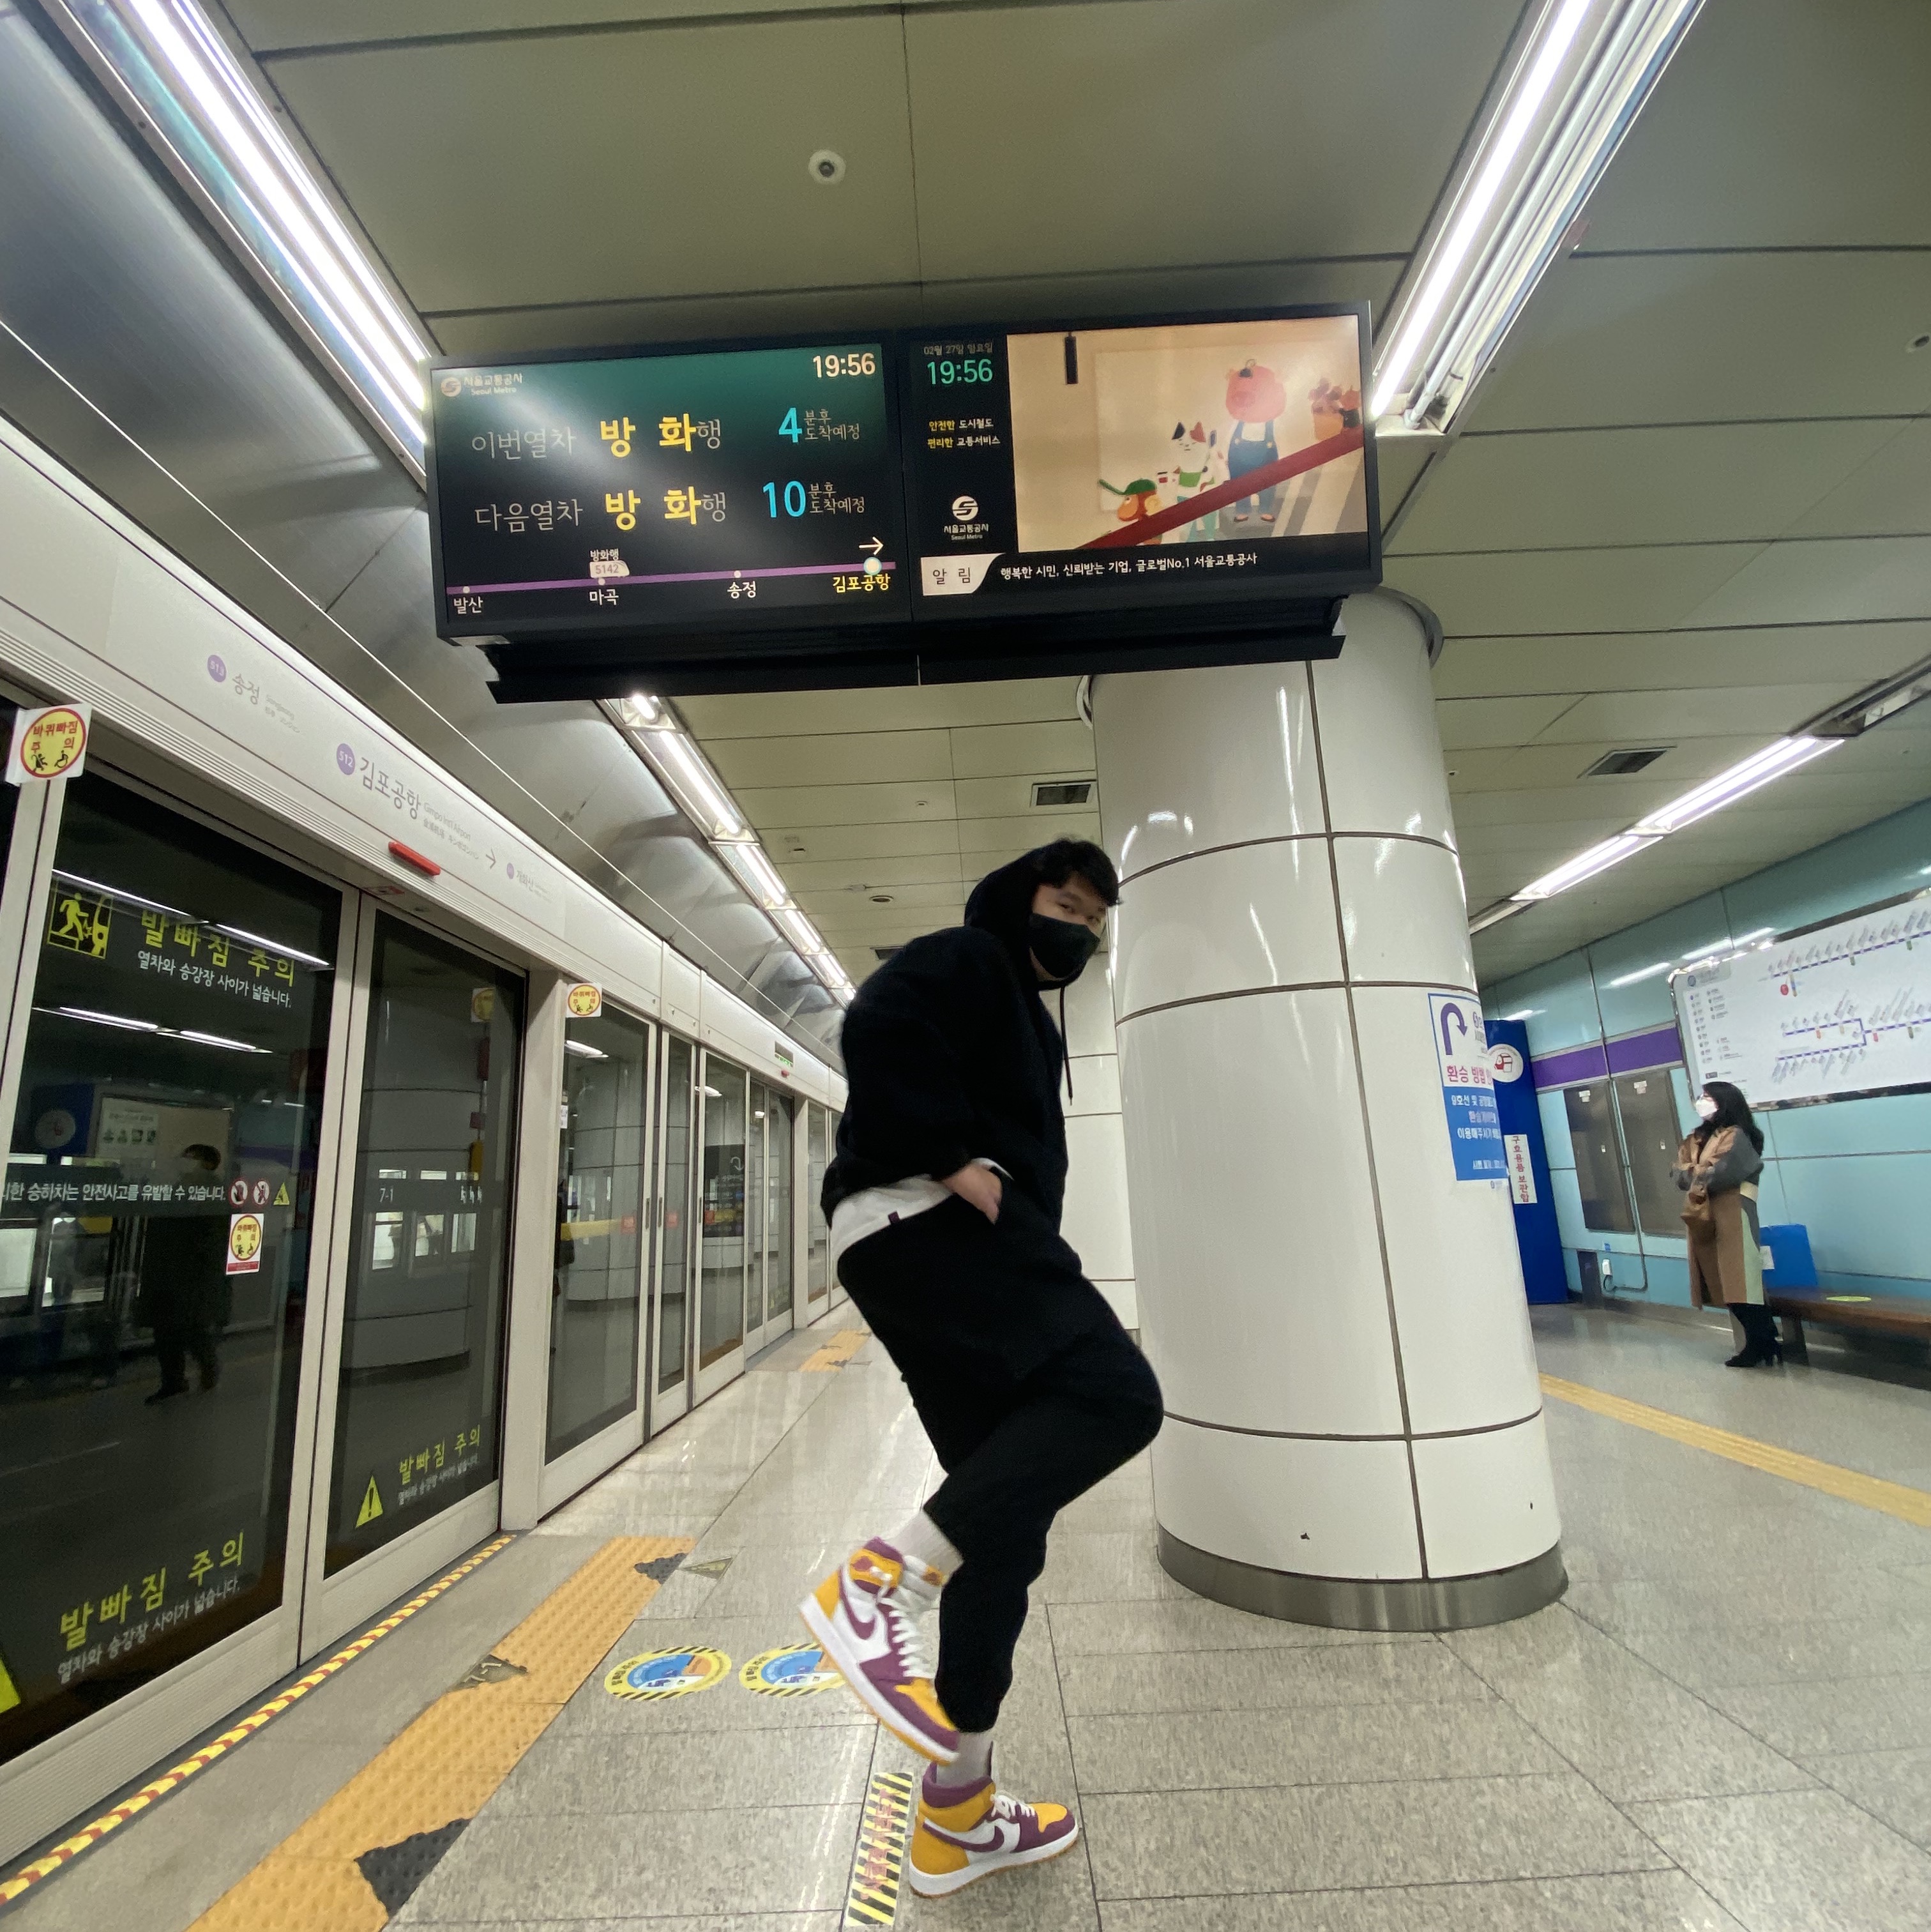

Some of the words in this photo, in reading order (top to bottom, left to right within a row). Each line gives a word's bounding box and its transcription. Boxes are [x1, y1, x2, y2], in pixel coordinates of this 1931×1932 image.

[813, 353, 876, 378] 19:56
[927, 358, 993, 384] 19:56
[471, 387, 492, 395] Seoul
[494, 386, 517, 395] Metro
[472, 427, 576, 460] 이번열차
[778, 407, 803, 443] 4
[803, 409, 831, 424] 분후
[805, 423, 860, 442] 도착예정
[928, 420, 955, 432] 안전한
[959, 418, 994, 429] 도시철도
[927, 437, 953, 449] 편리한
[957, 435, 1001, 446] 교통서비스
[474, 499, 583, 533] 다음열차
[762, 480, 806, 518] 10
[808, 481, 837, 499] 분후
[810, 496, 865, 515] 도착예정
[590, 548, 619, 561] 방화행
[595, 564, 619, 574] 5142
[1000, 566, 1033, 581] 행복한
[1036, 565, 1059, 579] 시민,
[1063, 563, 1105, 579] 신뢰받는
[1108, 560, 1132, 574] 기업,
[1194, 552, 1258, 568] 서울교통공사
[727, 581, 757, 599] 송정
[832, 574, 891, 594] 김포공항
[453, 596, 483, 614] 발산
[589, 589, 619, 606] 마곡
[232, 674, 260, 705] 송정
[338, 750, 353, 768] 512
[360, 757, 421, 819] 김포공항
[138, 950, 176, 976] 열차와
[179, 962, 215, 987] 승강장
[218, 975, 249, 997] 사이가
[1446, 1065, 1469, 1083] 환승
[27, 1182, 79, 1201] 승하차는
[82, 1183, 139, 1201] 안전사고를
[141, 1184, 173, 1201] 유발할
[175, 1185, 185, 1201] 수
